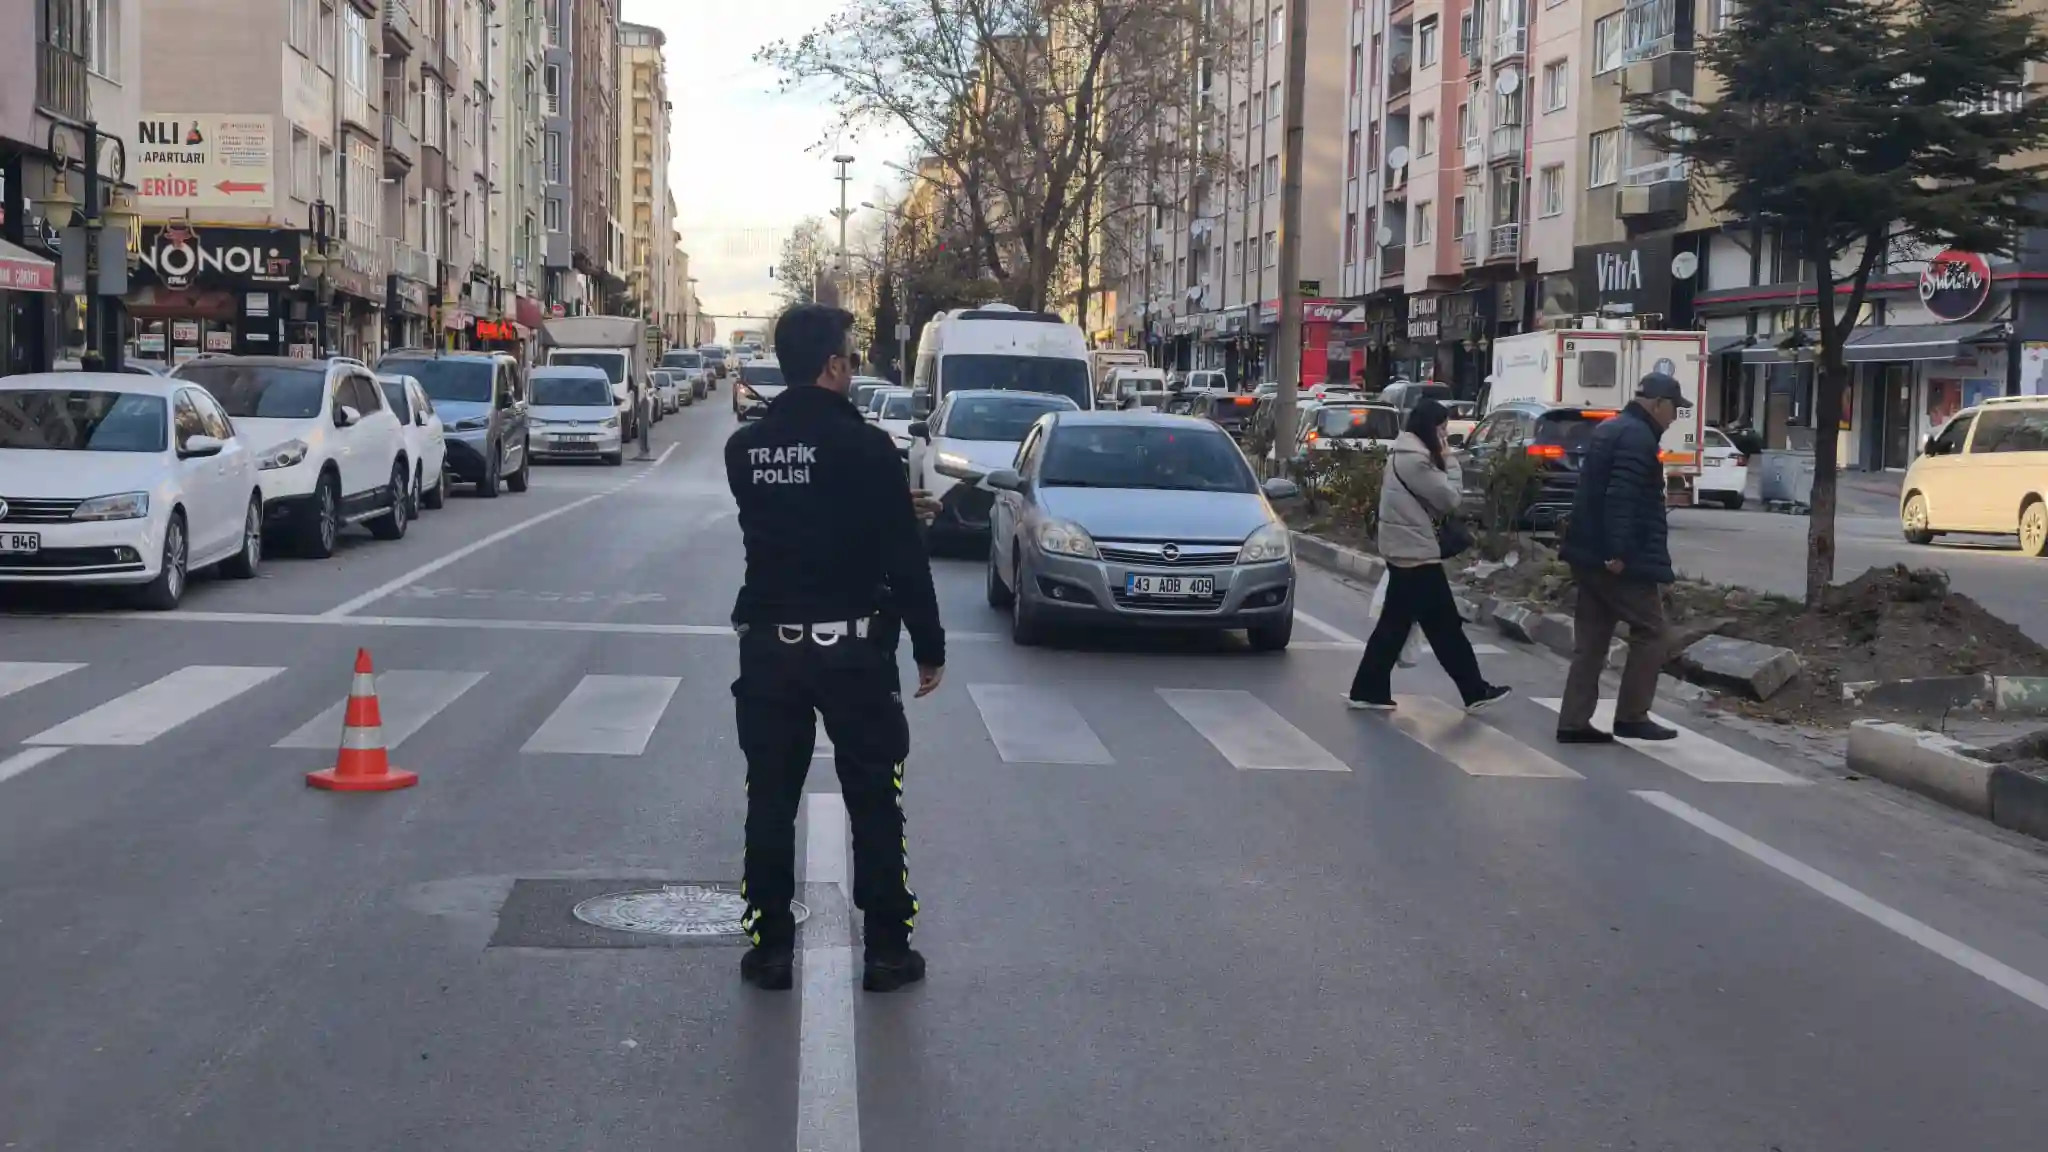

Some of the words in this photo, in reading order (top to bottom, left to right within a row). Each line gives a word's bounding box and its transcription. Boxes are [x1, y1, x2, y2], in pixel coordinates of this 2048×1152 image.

[1596, 249, 1641, 292] VitrA
[747, 442, 817, 465] TRAFİK
[752, 464, 810, 485] POLİSİ
[12, 535, 37, 549] 846
[1134, 577, 1150, 592] 43
[1158, 578, 1181, 593] ADB
[1189, 579, 1212, 594] 409
